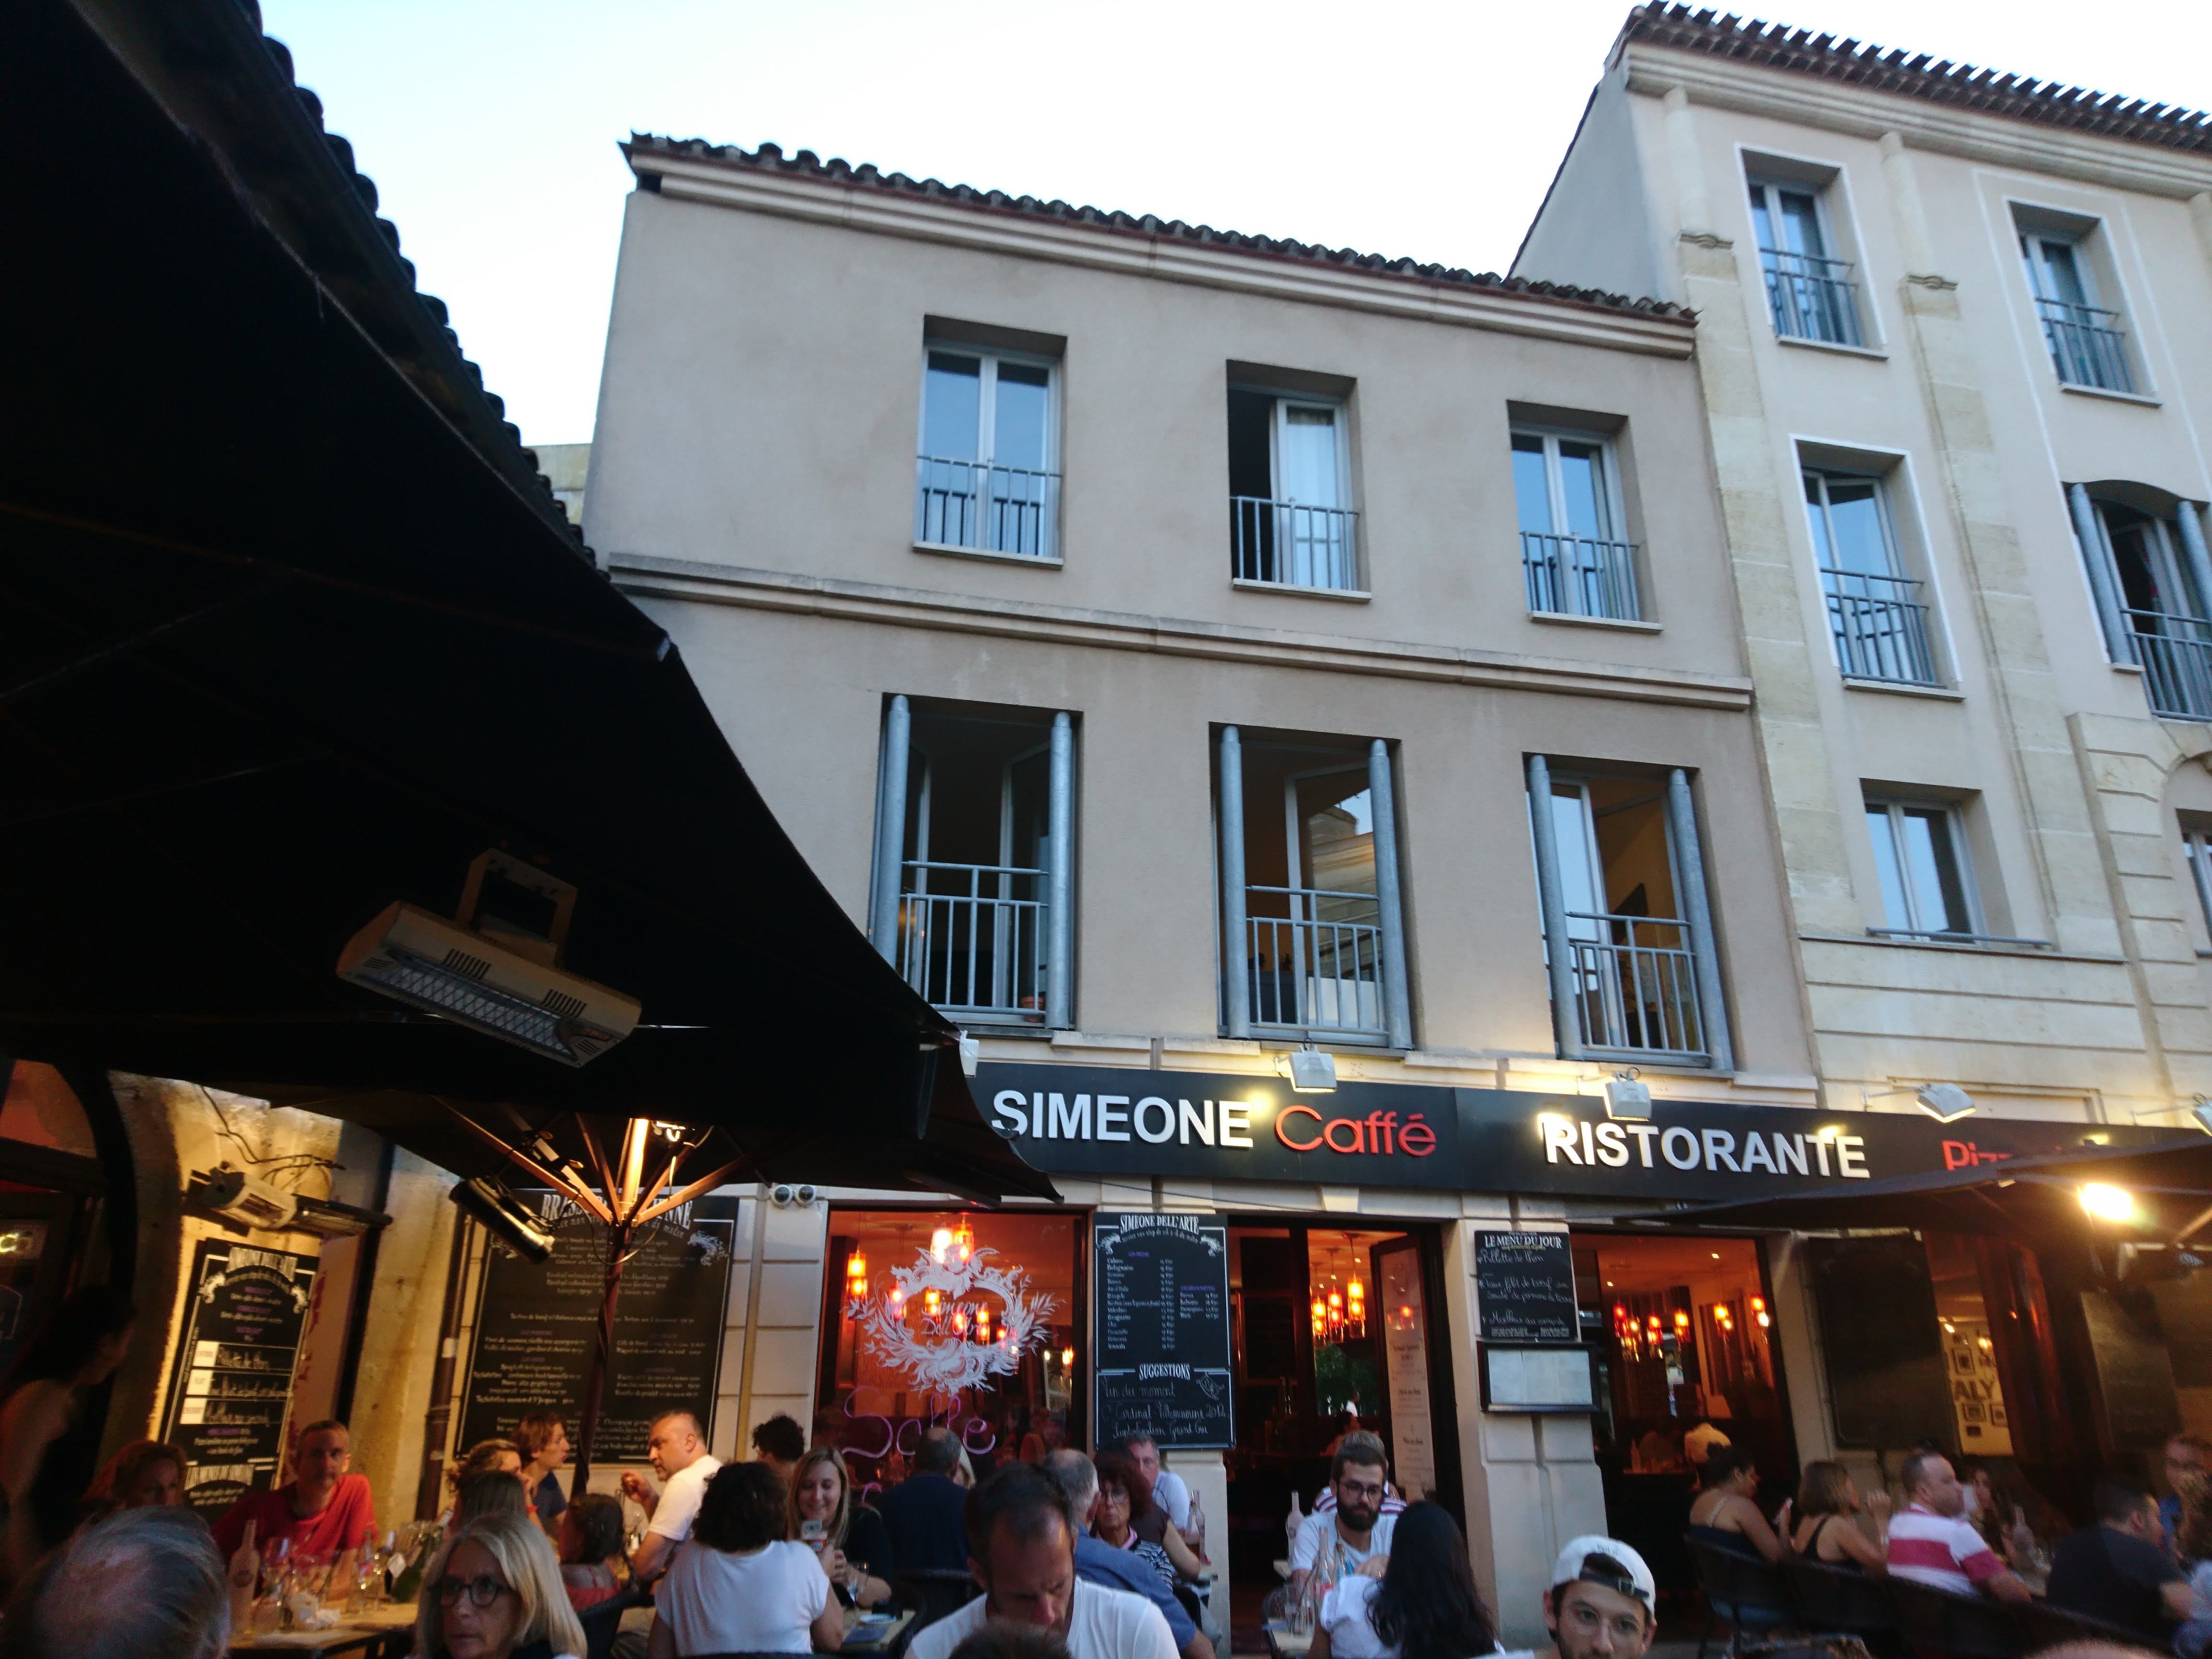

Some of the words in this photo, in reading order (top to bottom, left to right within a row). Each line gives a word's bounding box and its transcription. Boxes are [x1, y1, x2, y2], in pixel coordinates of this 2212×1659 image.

[992, 1089, 1254, 1148] SIMEONE
[1273, 1104, 1436, 1157] Caffé
[1539, 1118, 1870, 1178] RISTORANTE
[1120, 1214, 1155, 1234] SIMEONE
[1157, 1215, 1199, 1235] DELL'ARTE
[1485, 1236, 1495, 1248] LE
[1496, 1235, 1523, 1246] MENU
[1524, 1236, 1538, 1246] DU
[1539, 1236, 1563, 1250] JOUR
[1139, 1363, 1190, 1381] SUGGESTIONS
[1102, 1375, 1118, 1398] Vin
[1121, 1384, 1135, 1398] du
[1141, 1380, 1176, 1398] moment
